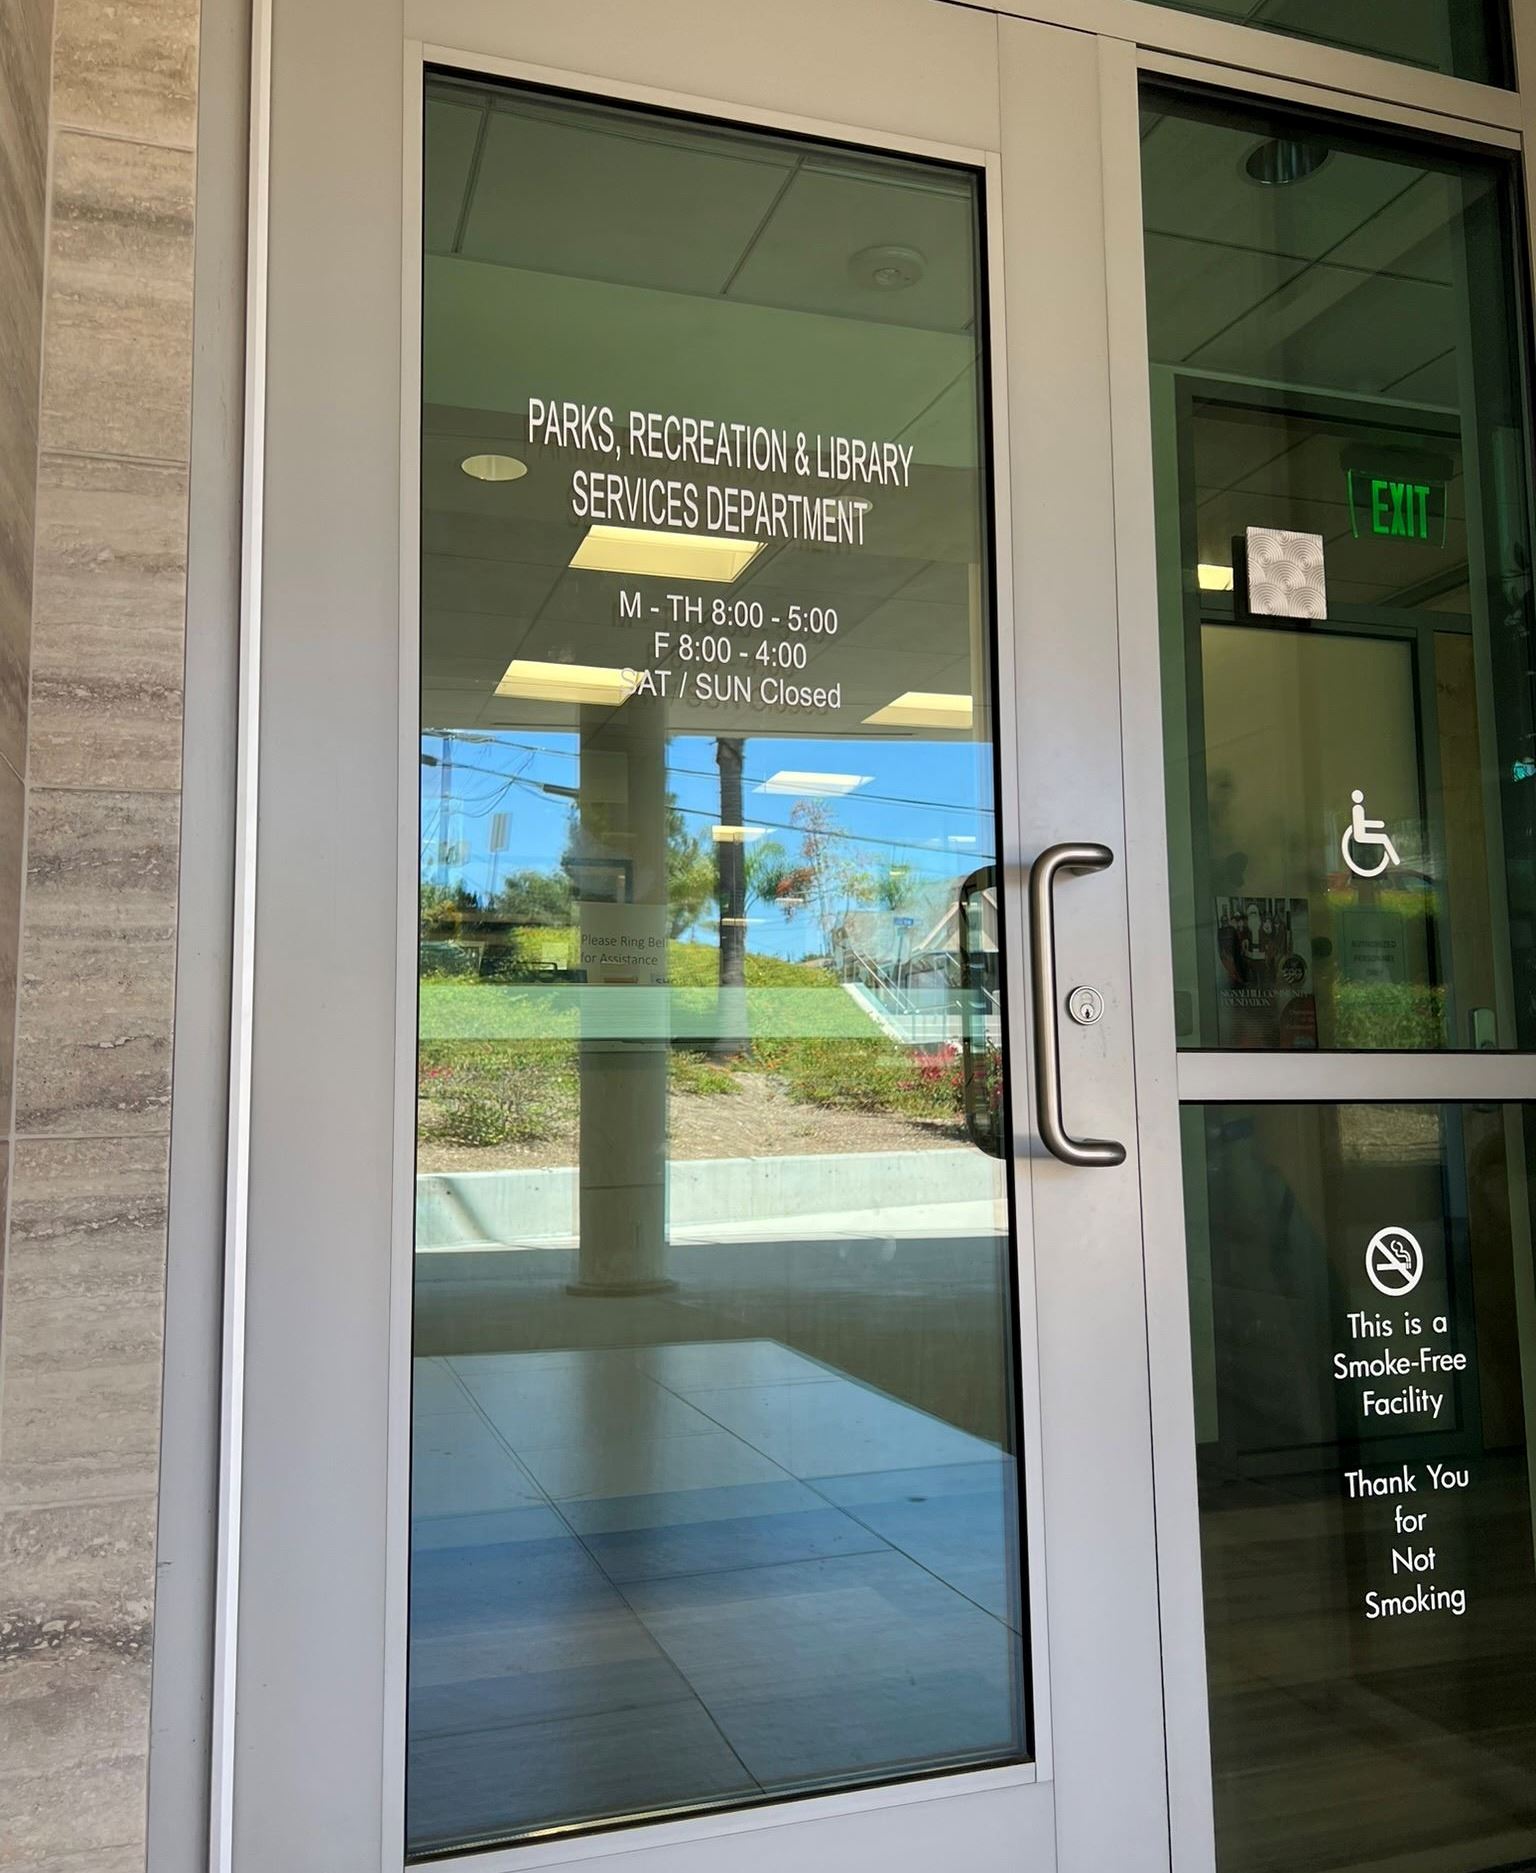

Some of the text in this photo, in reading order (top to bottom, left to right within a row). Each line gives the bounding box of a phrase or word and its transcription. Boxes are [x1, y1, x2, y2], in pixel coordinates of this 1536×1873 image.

[529, 397, 914, 487] PARKS, RECREATION & LIBRARY
[572, 470, 868, 545] SERVICES DEPARTMENT
[1371, 480, 1430, 540] EXIT
[620, 590, 641, 618] M
[667, 594, 702, 623] TH
[712, 599, 763, 628] 8:00
[788, 605, 838, 634] 5:00
[654, 632, 670, 658] F
[679, 634, 731, 663] 8:00
[756, 640, 807, 669] 4:00
[621, 667, 841, 709] SAT / SUN Closed
[581, 934, 617, 946] Please
[620, 936, 645, 950] Ring
[581, 951, 658, 966] for Assistance
[1347, 1311, 1448, 1338] This is a
[1333, 1347, 1467, 1379] Smoke-Free
[1363, 1385, 1444, 1419] Facility
[1344, 1464, 1469, 1499] Thank You
[1395, 1505, 1427, 1534] for
[1391, 1547, 1436, 1574] Not
[1365, 1584, 1466, 1619] Smoking
